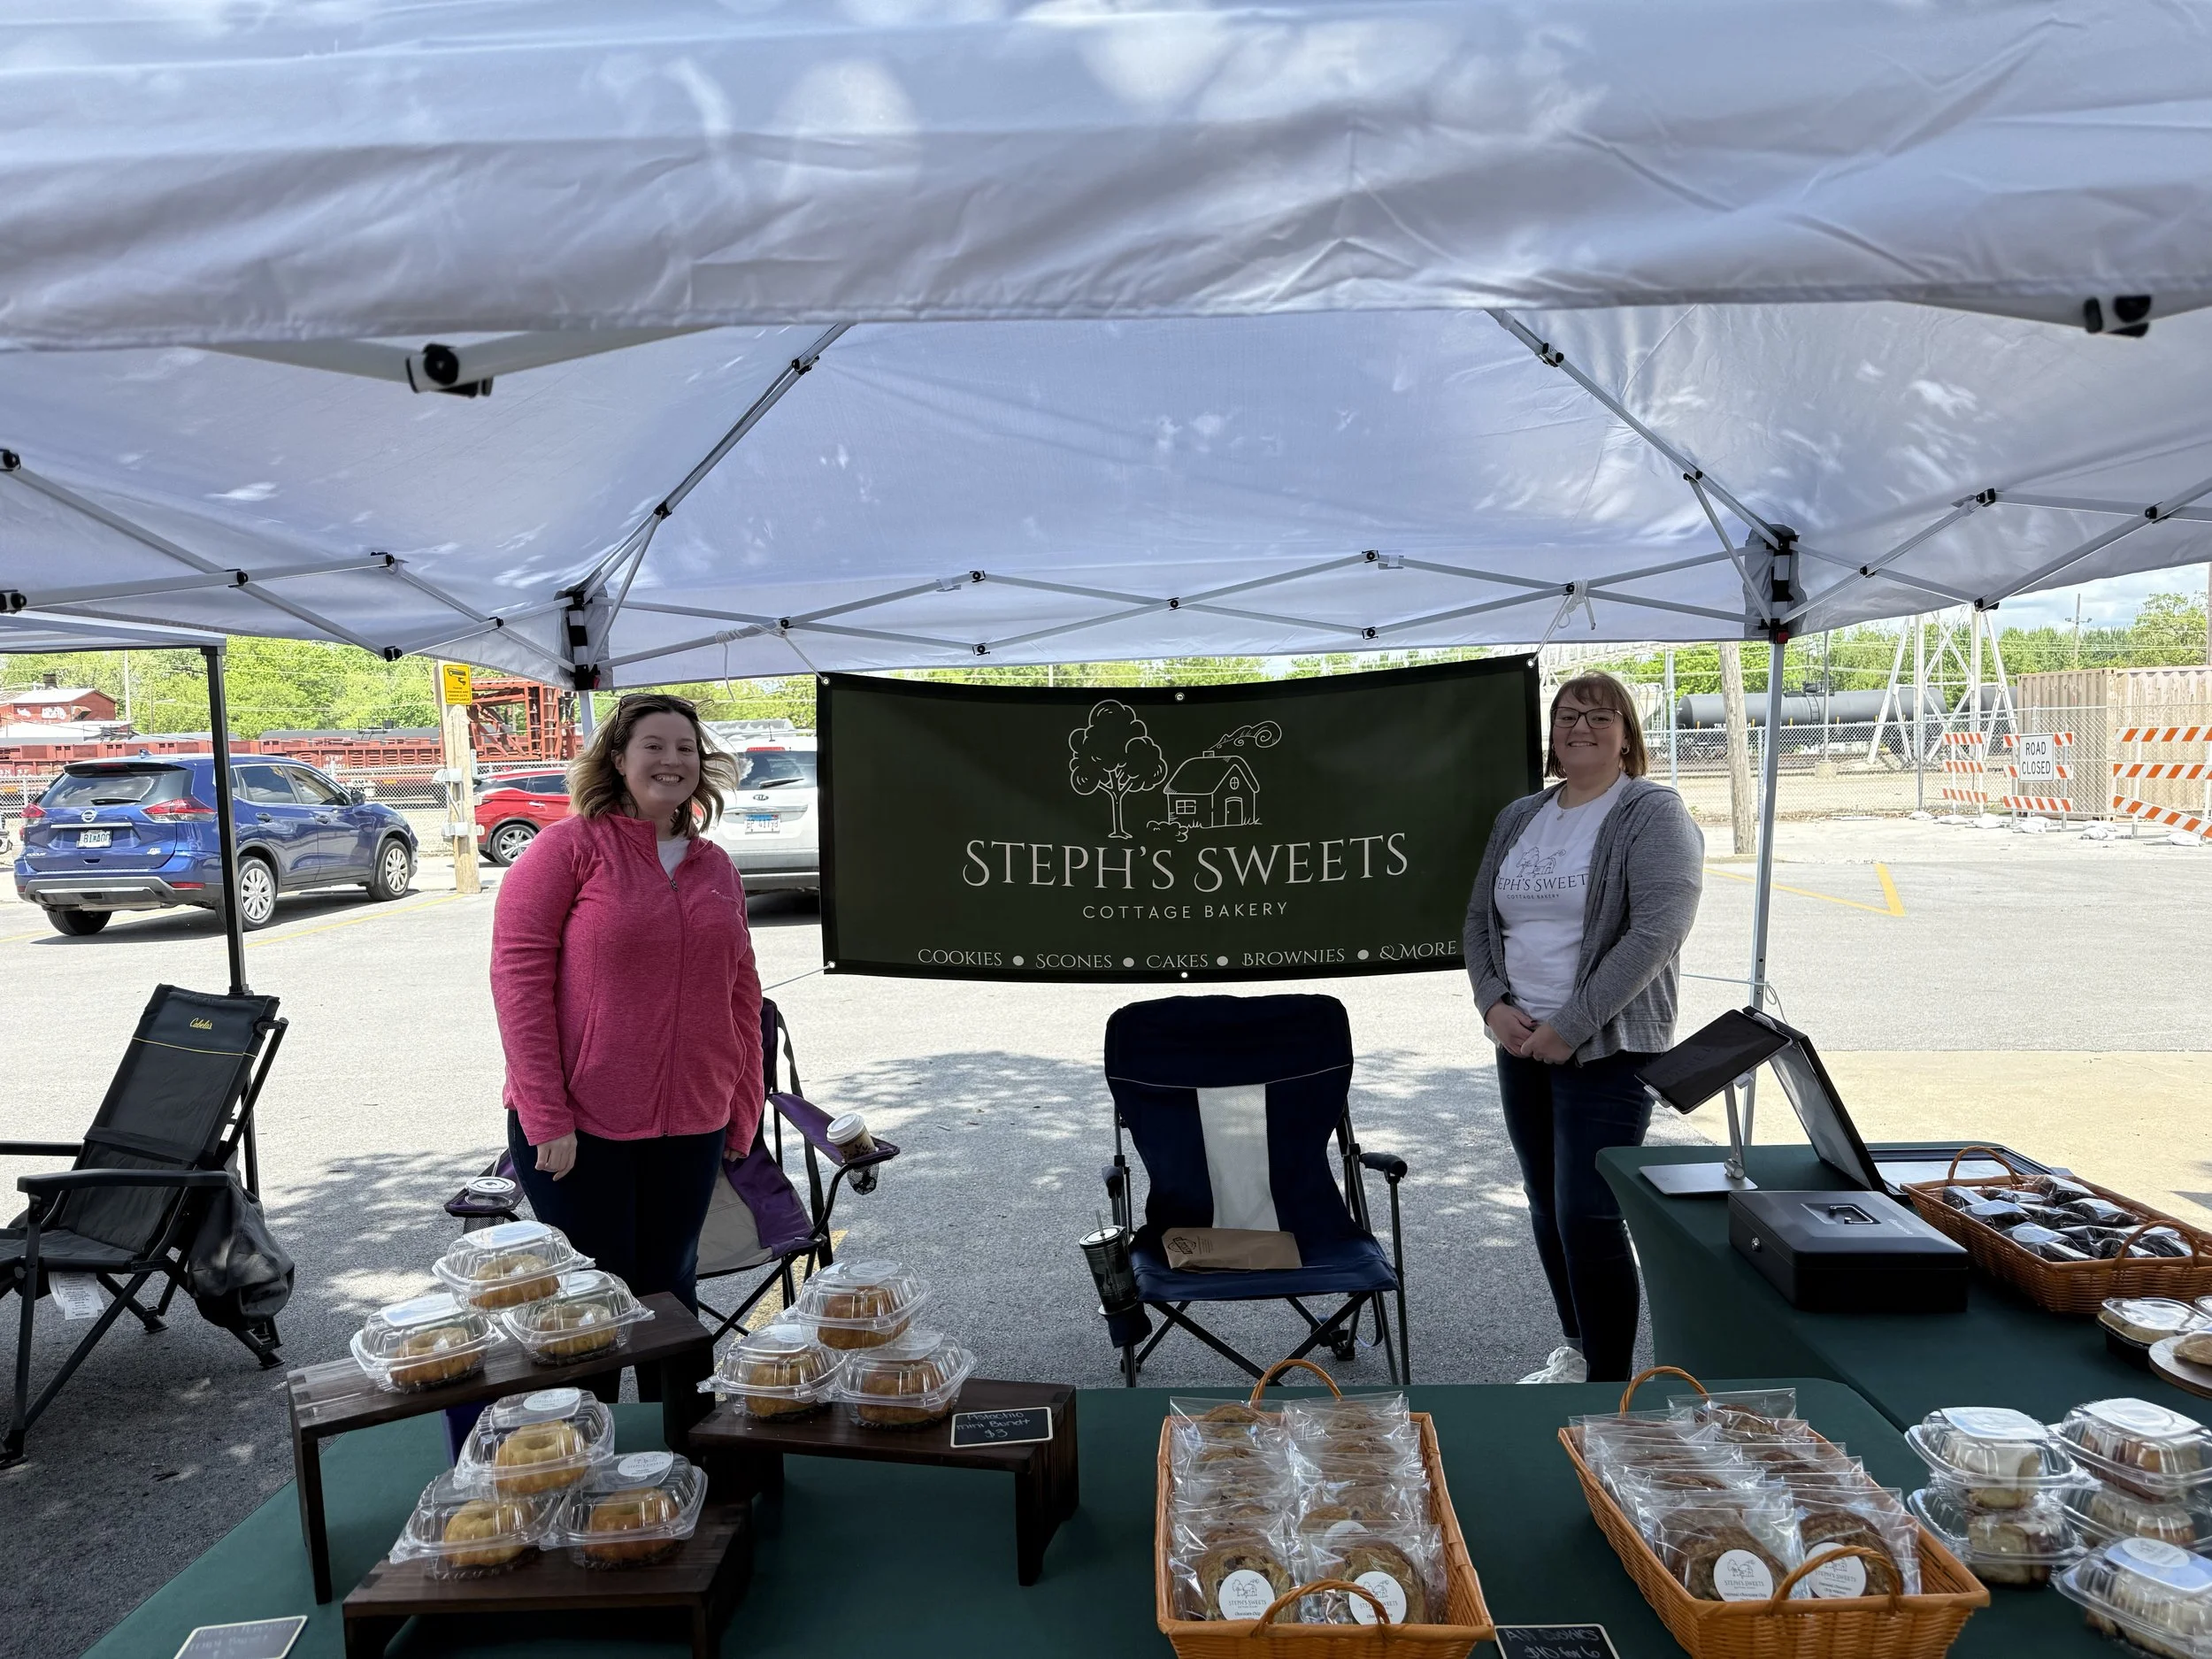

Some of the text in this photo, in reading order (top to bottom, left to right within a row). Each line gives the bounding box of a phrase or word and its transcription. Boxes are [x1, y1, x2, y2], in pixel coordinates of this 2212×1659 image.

[2025, 741, 2047, 756] ROAD
[2022, 761, 2051, 775] CLOSED
[963, 833, 1408, 893] STEPH'S SWEETS
[1533, 872, 1589, 892] SWEET
[1082, 902, 1287, 919] COTTAGE BAKERY
[918, 949, 1002, 966] COOKIES
[1035, 953, 1113, 969] SCONES
[1146, 954, 1209, 969] CAKES
[1241, 948, 1346, 966] BROWNIES
[1580, 1645, 1601, 1659] 6
